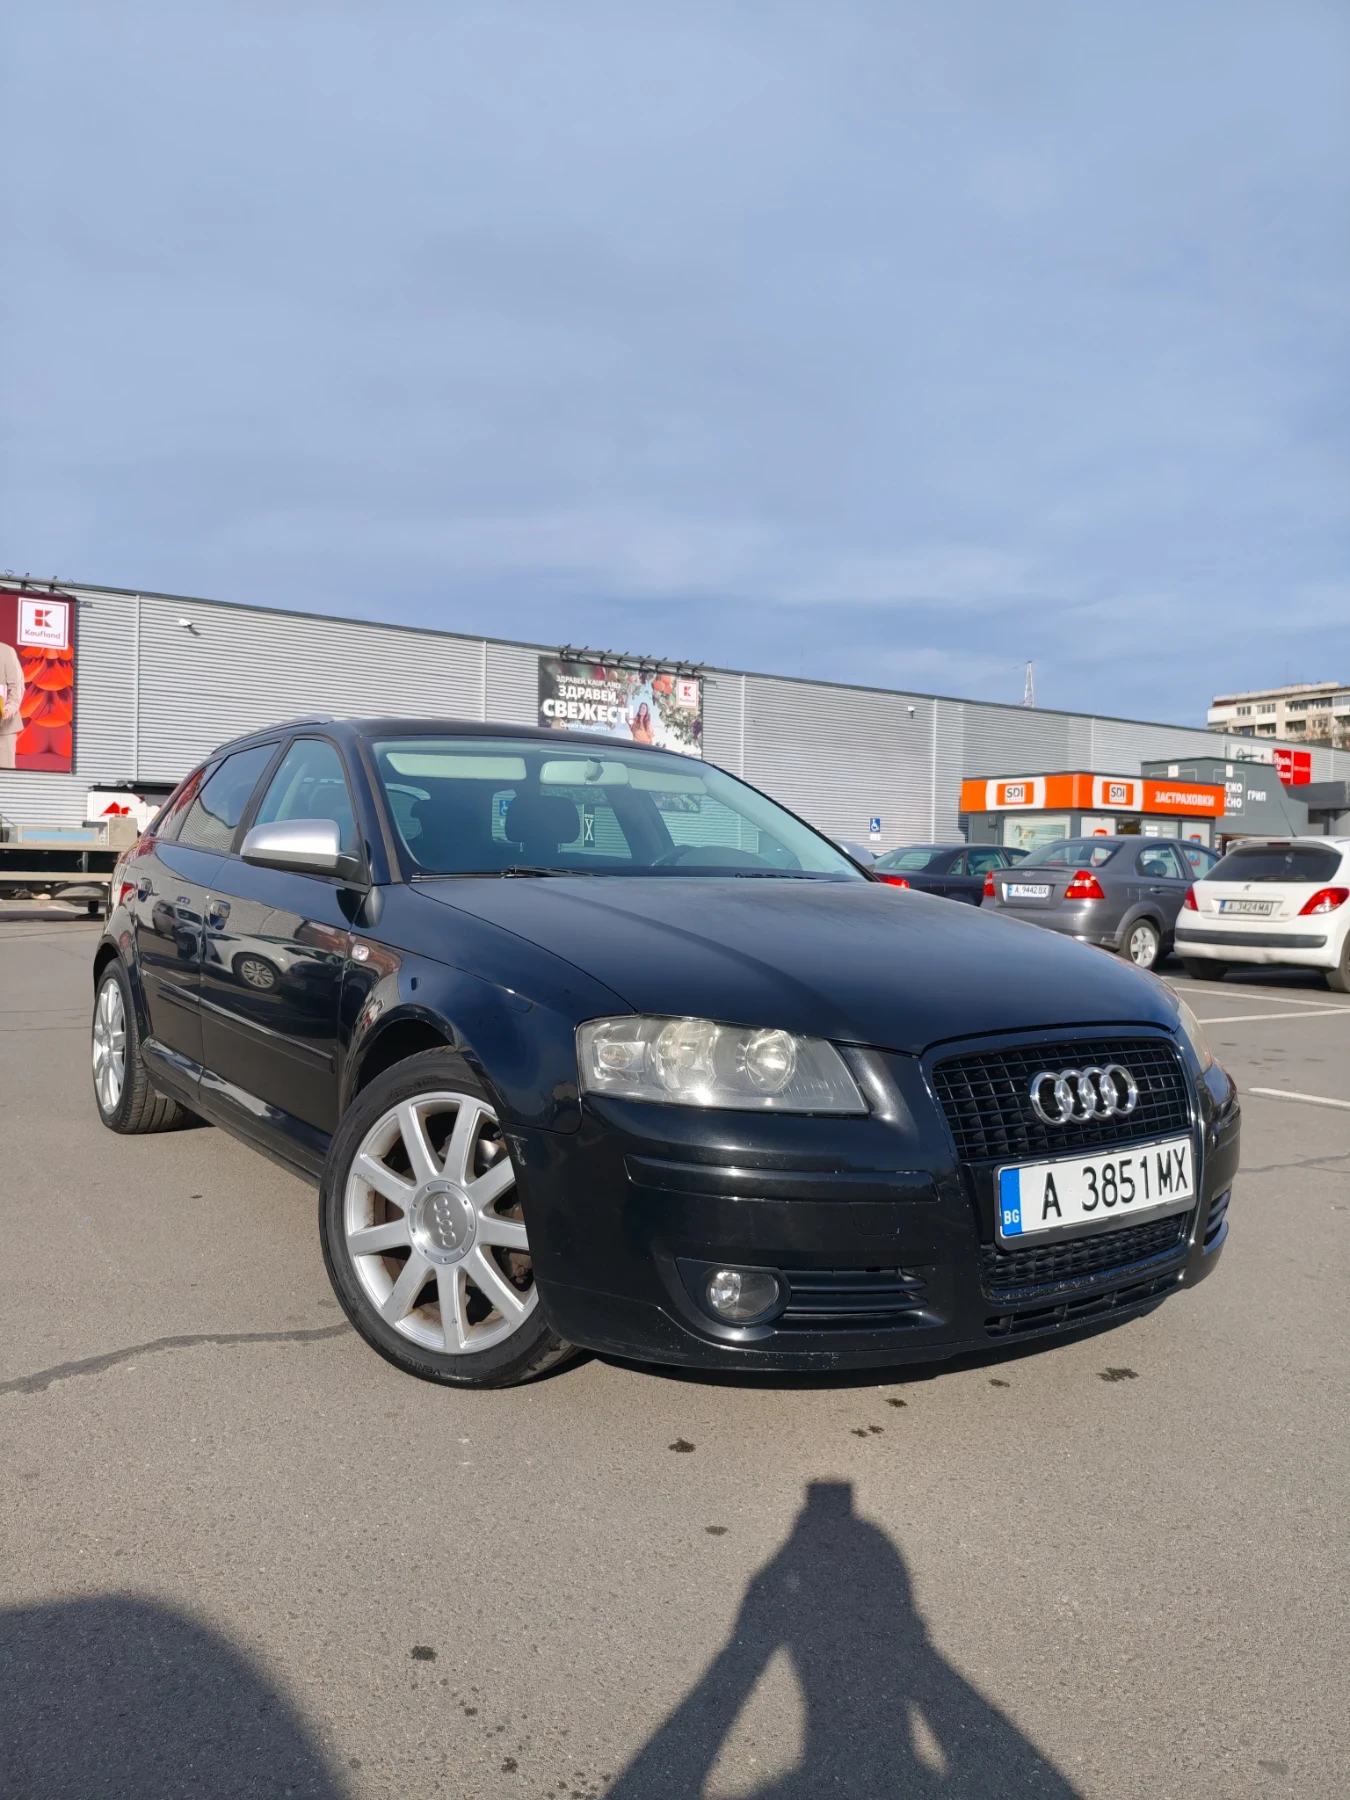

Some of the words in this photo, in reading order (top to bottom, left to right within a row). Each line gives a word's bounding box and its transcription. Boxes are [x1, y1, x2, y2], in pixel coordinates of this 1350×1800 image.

[25, 629, 61, 640] Kaufland
[558, 685, 619, 705] ЗДРАВЕЙ,
[542, 698, 635, 725] СВЕЖЕСТ!
[1006, 787, 1024, 798] SDI
[1111, 787, 1125, 798] SDI
[1155, 790, 1215, 807] ЗАСТРАХОВКИ
[1041, 1171, 1062, 1221] A
[1003, 1209, 1020, 1225] BG
